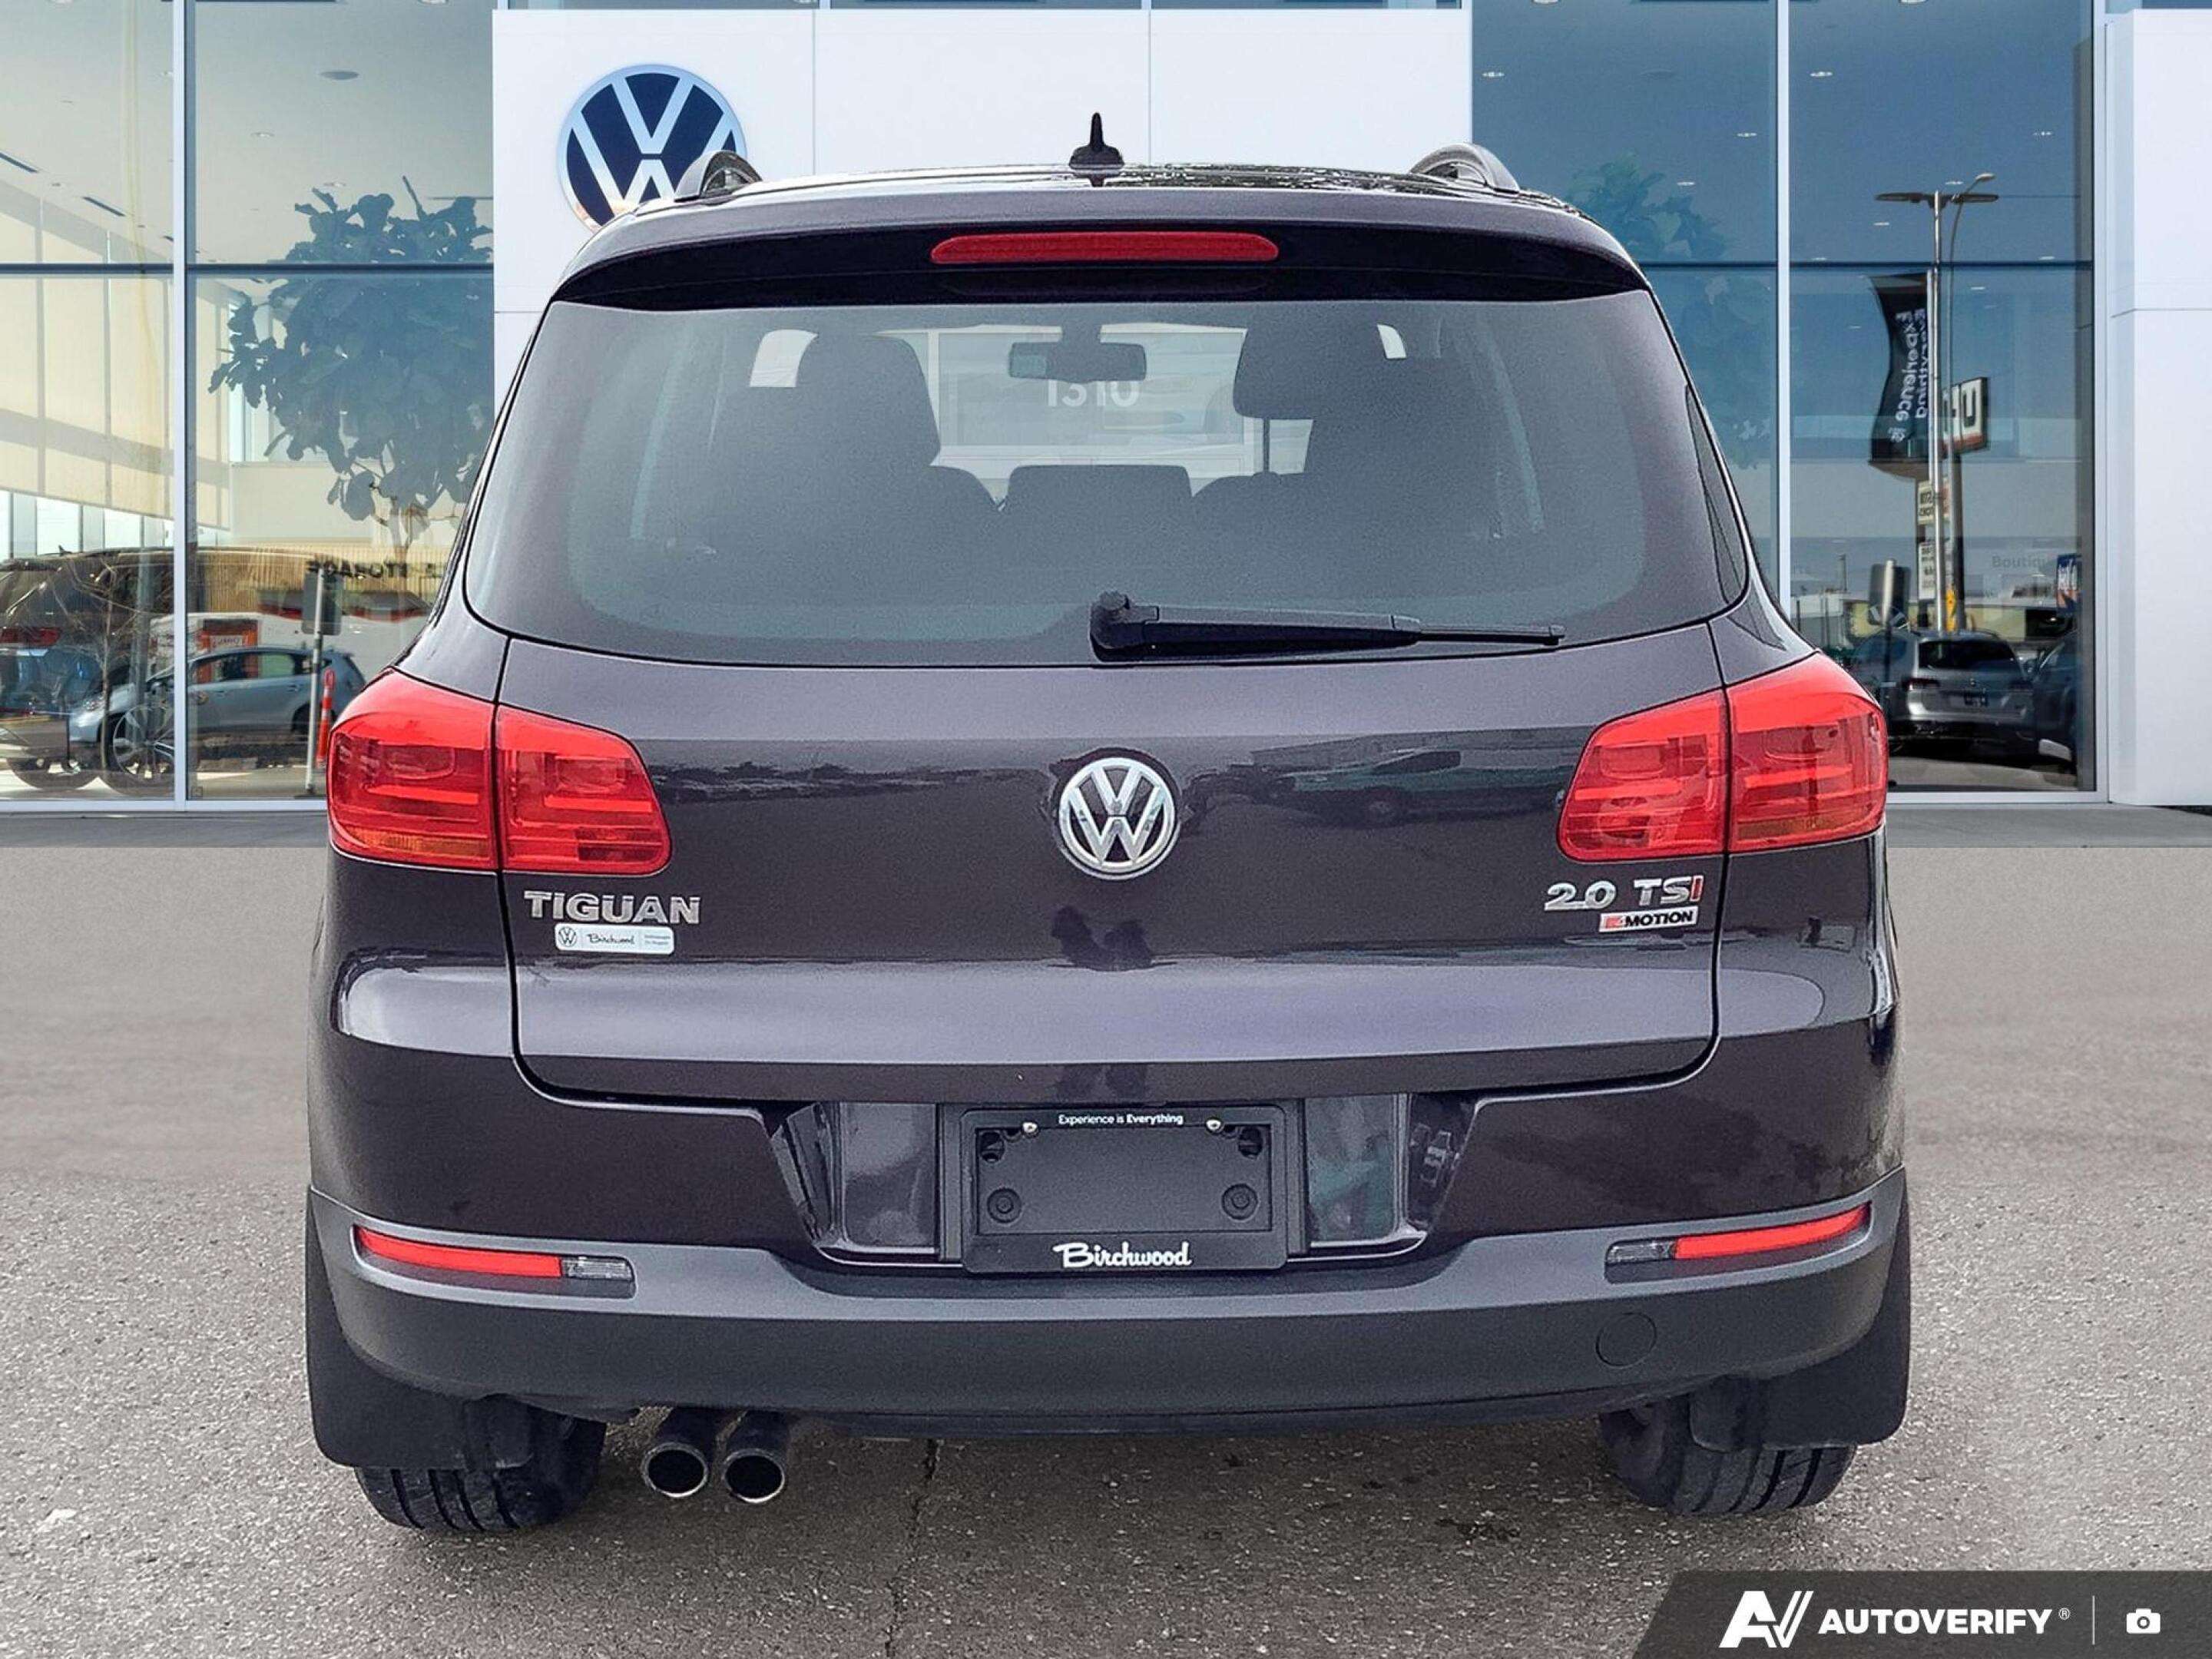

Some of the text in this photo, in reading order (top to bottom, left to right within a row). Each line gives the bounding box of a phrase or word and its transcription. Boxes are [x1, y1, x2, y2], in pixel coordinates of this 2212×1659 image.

[1634, 875, 1704, 906] TSI
[524, 890, 700, 924] TIGUAN
[1058, 1114, 1114, 1126] Experience
[1126, 1113, 1184, 1125] Everything
[1052, 1240, 1193, 1268] Birchwood
